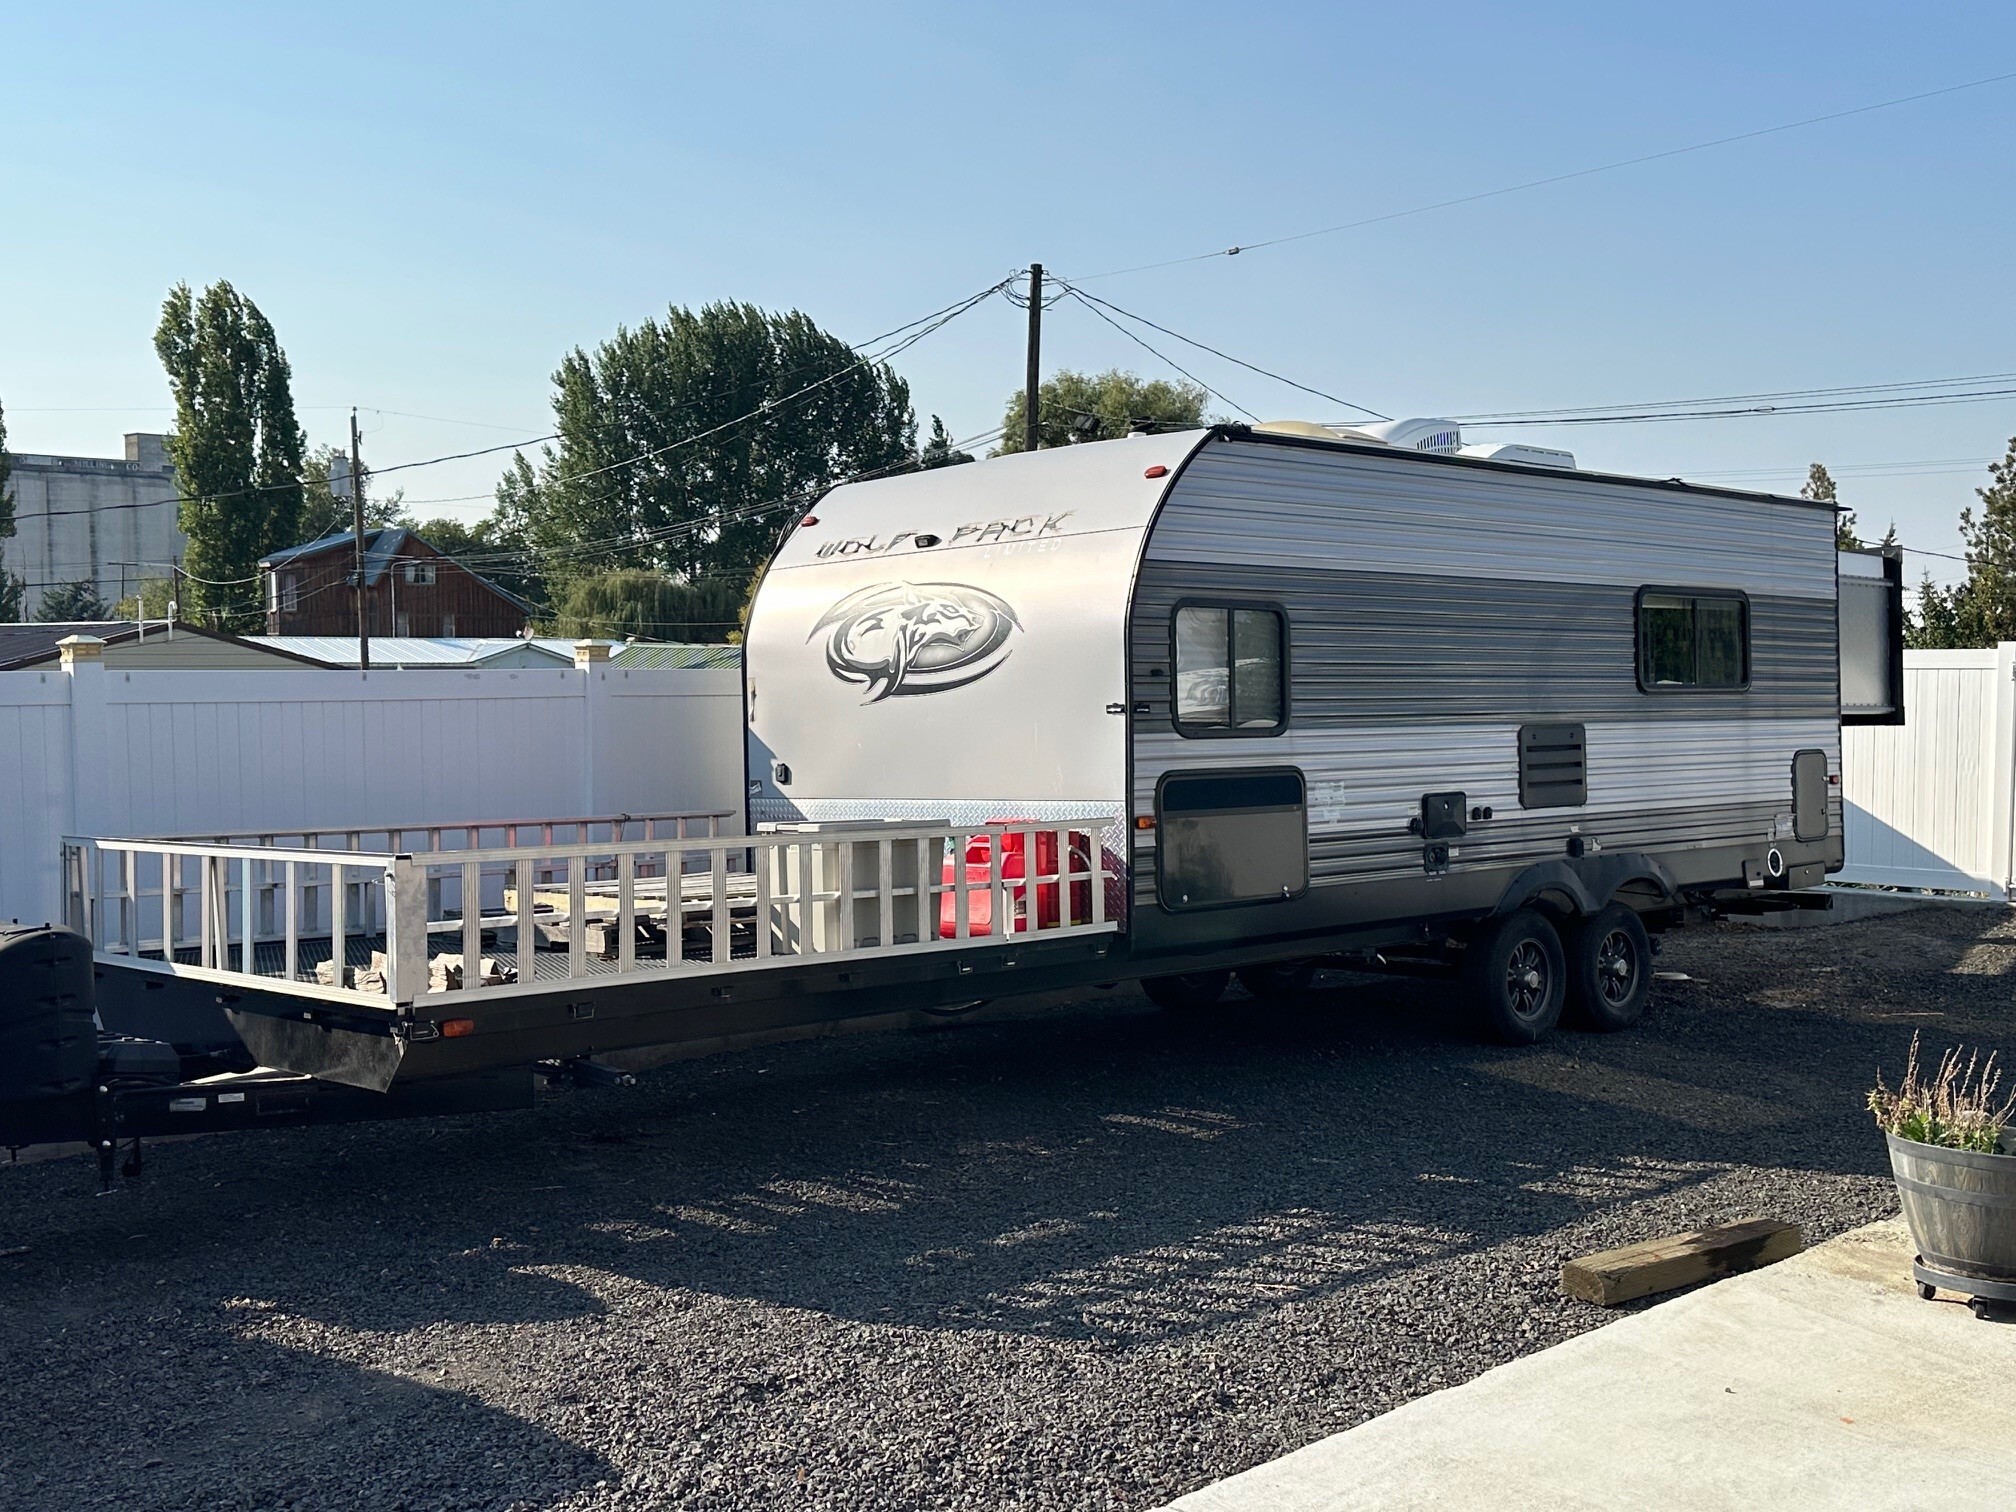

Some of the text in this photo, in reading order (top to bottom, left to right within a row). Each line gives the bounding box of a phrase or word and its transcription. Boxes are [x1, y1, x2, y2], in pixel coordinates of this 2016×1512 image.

[815, 510, 1076, 558] WOLF PACK
[983, 538, 1061, 559] LIMITED
